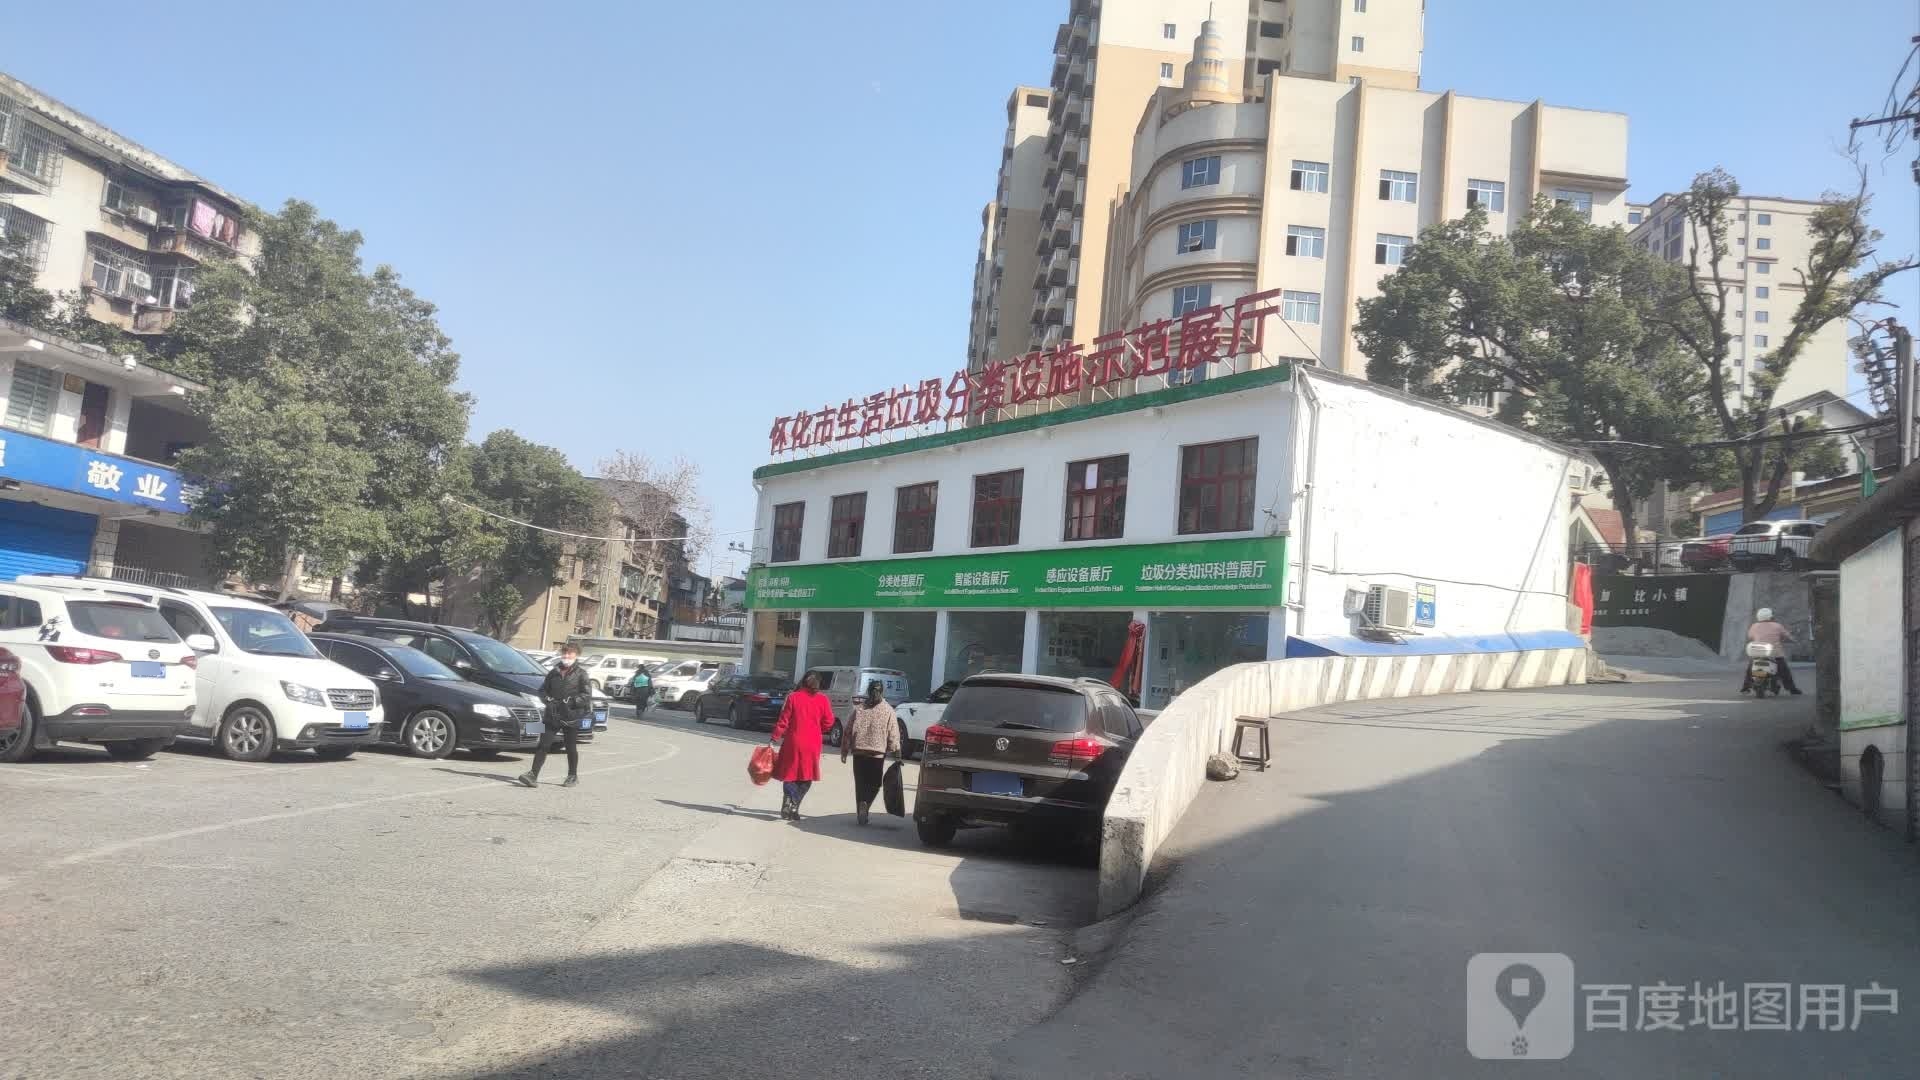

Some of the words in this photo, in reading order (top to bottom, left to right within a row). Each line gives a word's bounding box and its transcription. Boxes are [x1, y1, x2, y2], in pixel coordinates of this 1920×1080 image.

[768, 288, 1281, 455] 怀化市生活垃圾分类设施示范展厅
[954, 571, 1010, 586] 智能设备展厅
[1046, 566, 1112, 583] 感应设备展厅
[1141, 560, 1267, 581] 垃圾分类知识科普展厅
[878, 574, 925, 588] 分类处理展厅
